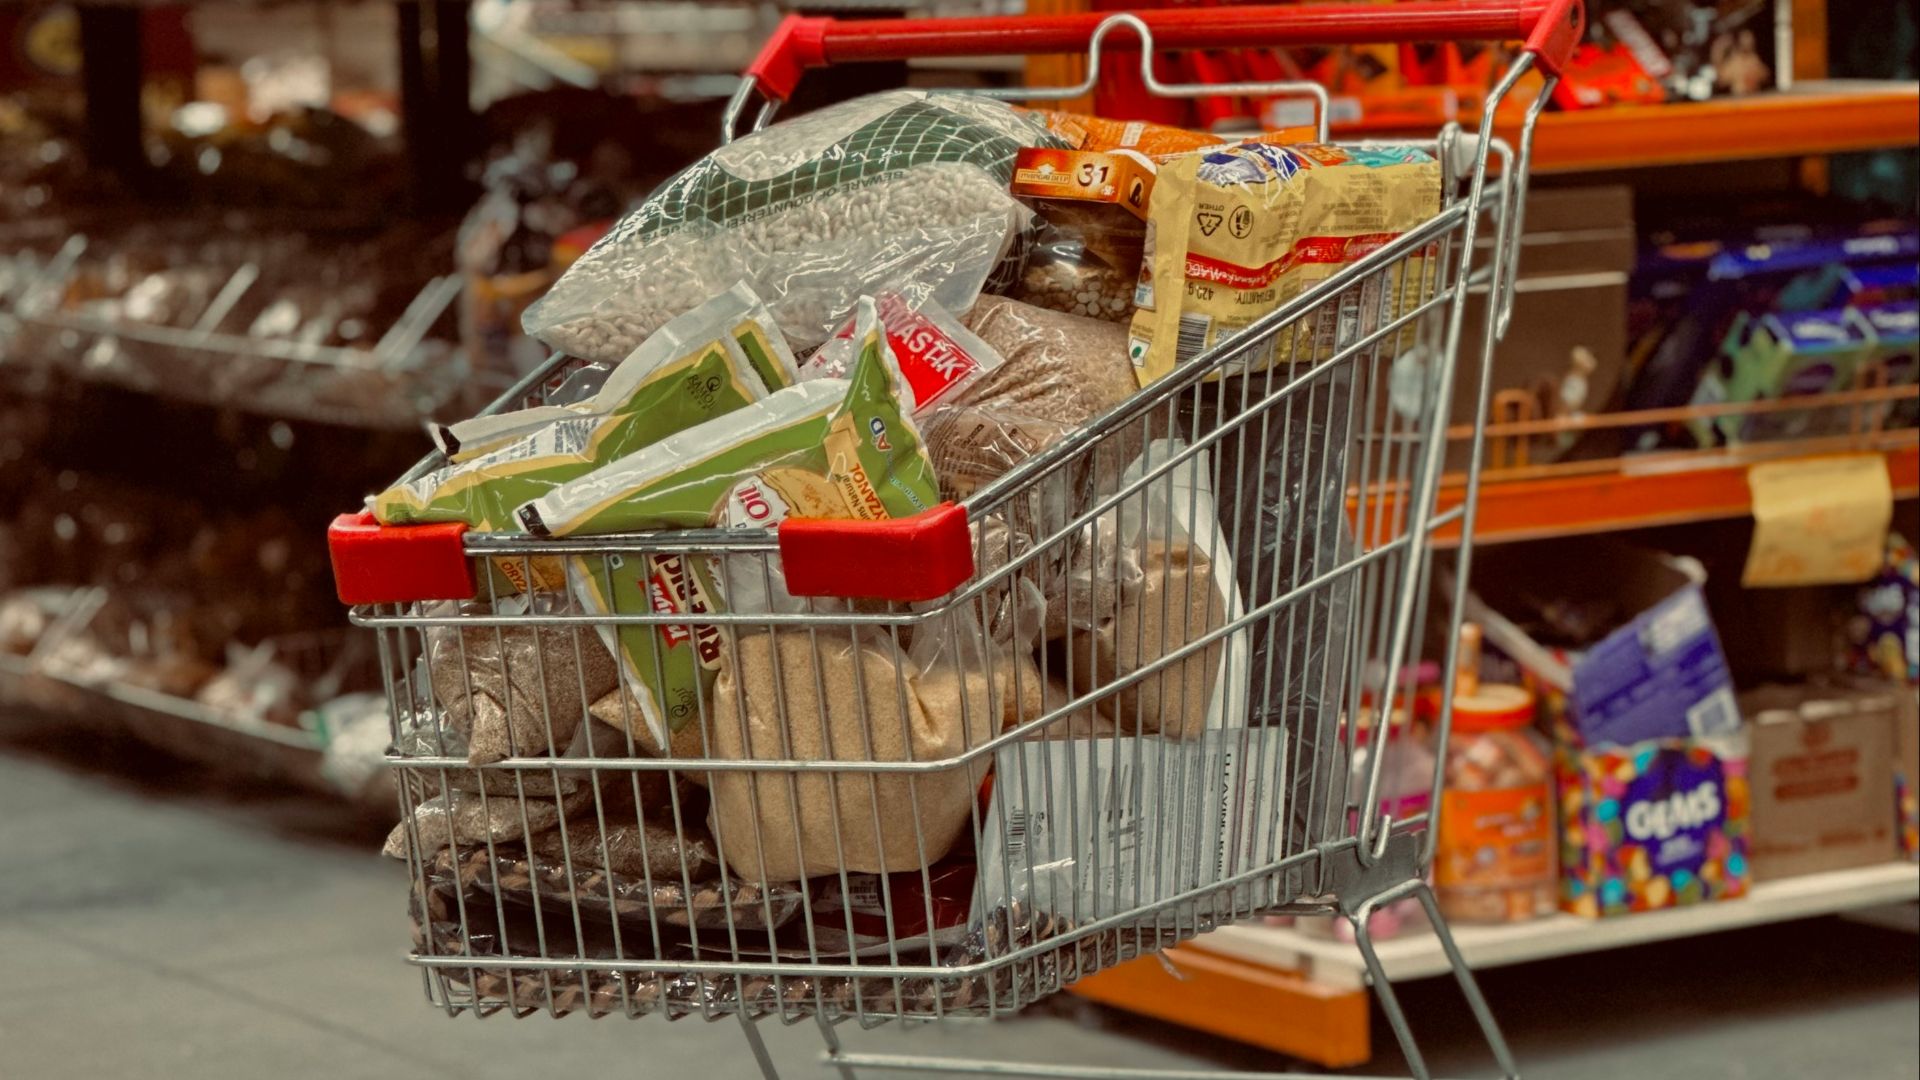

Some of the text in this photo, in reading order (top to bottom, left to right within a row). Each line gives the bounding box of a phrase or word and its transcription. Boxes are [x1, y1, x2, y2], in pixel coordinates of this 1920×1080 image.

[841, 170, 905, 195] BEWARE
[1077, 163, 1109, 187] 31
[814, 186, 842, 201] OF
[849, 462, 888, 520] YZANOL
[1625, 784, 1720, 841] GEMS
